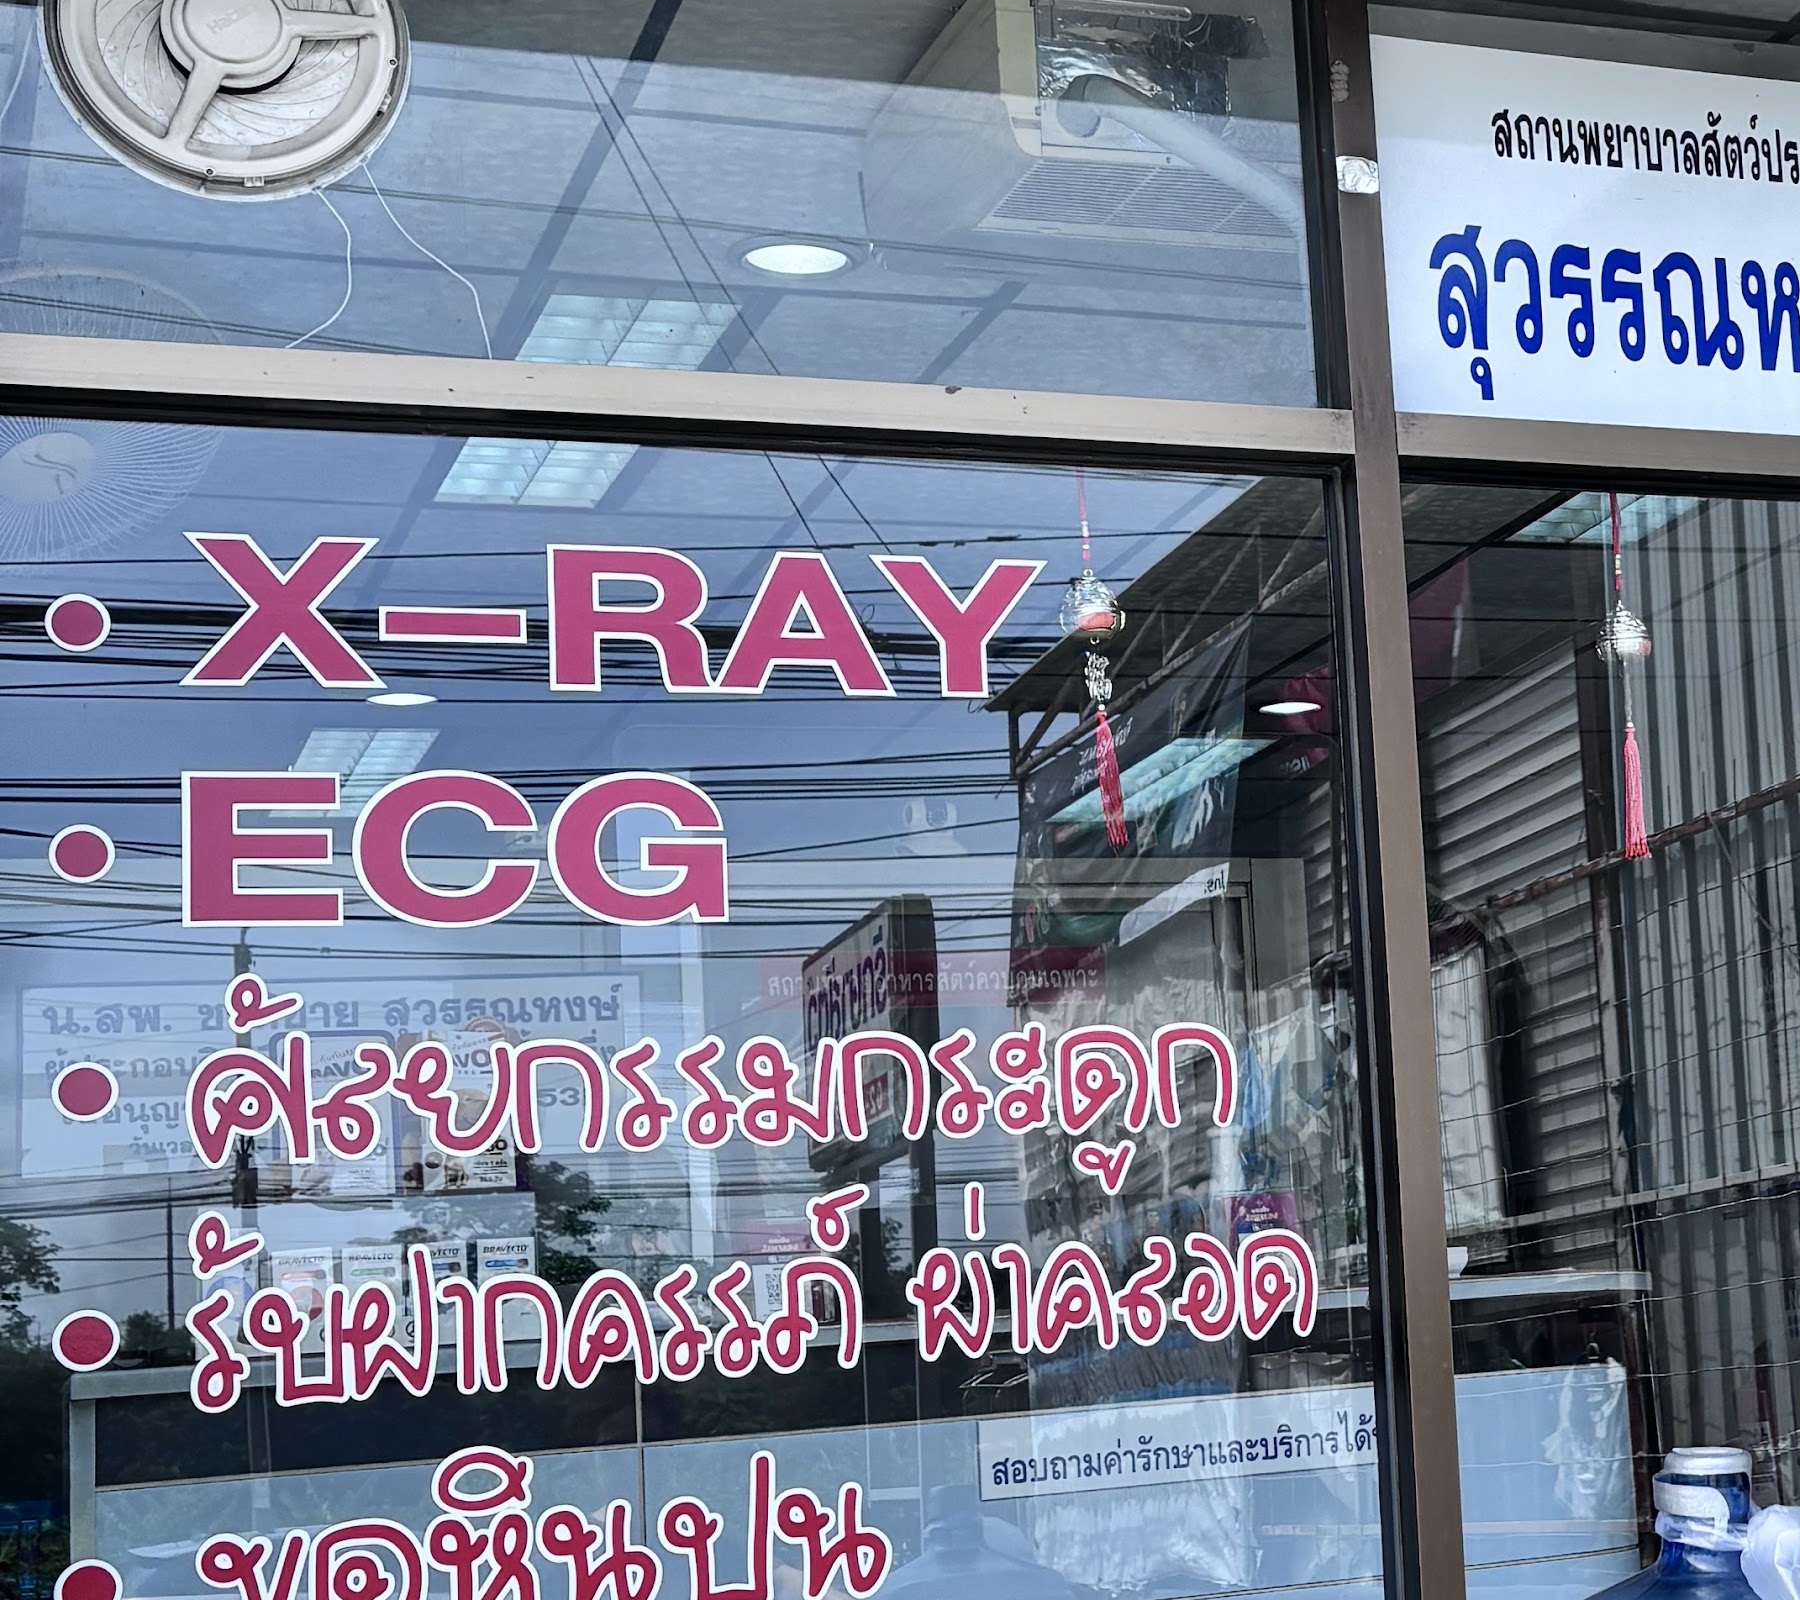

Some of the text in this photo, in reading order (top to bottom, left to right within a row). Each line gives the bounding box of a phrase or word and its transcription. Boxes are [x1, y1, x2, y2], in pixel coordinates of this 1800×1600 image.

[180, 530, 1048, 699] X-RAY
[180, 770, 730, 929] ECG
[186, 972, 1240, 1198] ศัลยกรรมกระดูก
[186, 1181, 1319, 1414] รับฝากครรภ์ ผ่าคลอด
[483, 1244, 529, 1255] BRAVECTO
[991, 1409, 1379, 1487] สอบถามค่ารักษาและบริการได้
